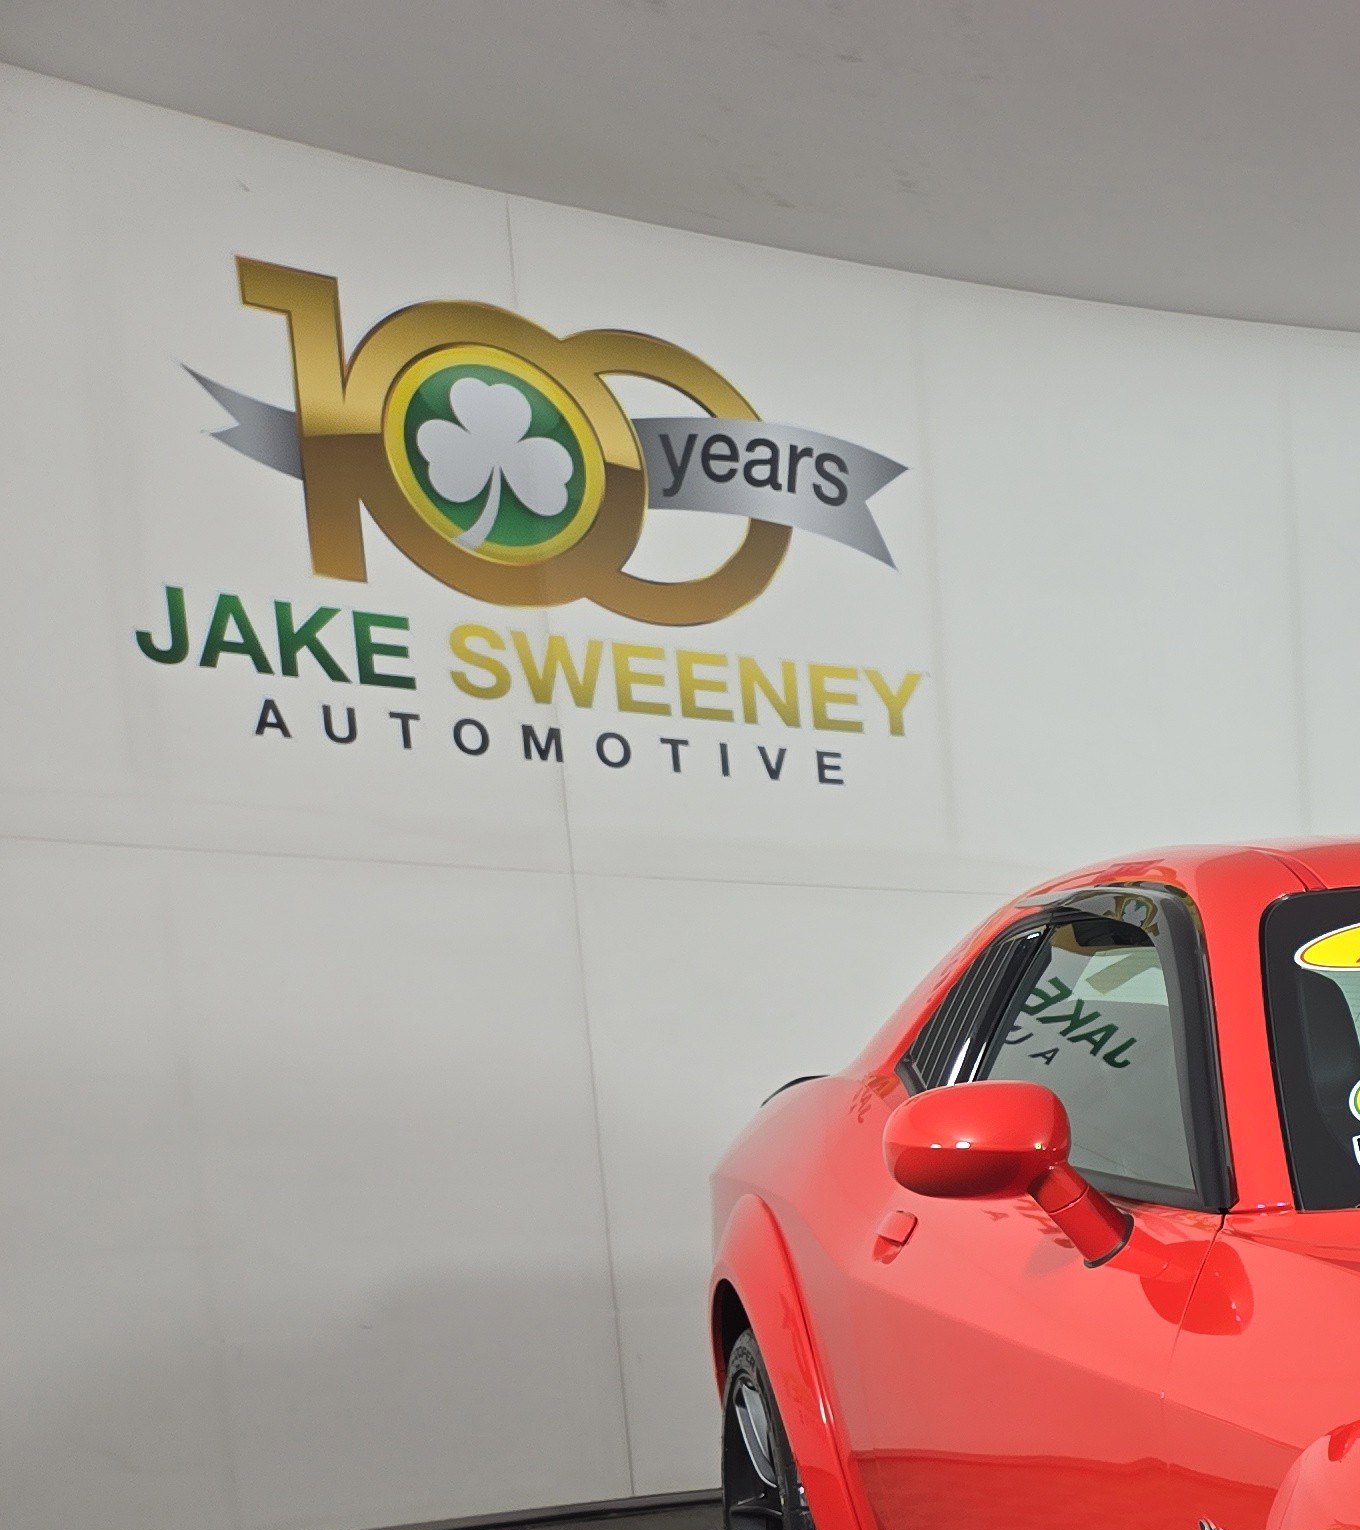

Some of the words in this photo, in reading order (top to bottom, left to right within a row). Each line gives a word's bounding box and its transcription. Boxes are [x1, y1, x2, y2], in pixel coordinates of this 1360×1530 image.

[233, 255, 793, 627] 100
[659, 426, 850, 506] years
[135, 585, 417, 690] JAKE
[449, 622, 921, 737] SWEENEY
[254, 698, 845, 785] AUTOMOTIVE
